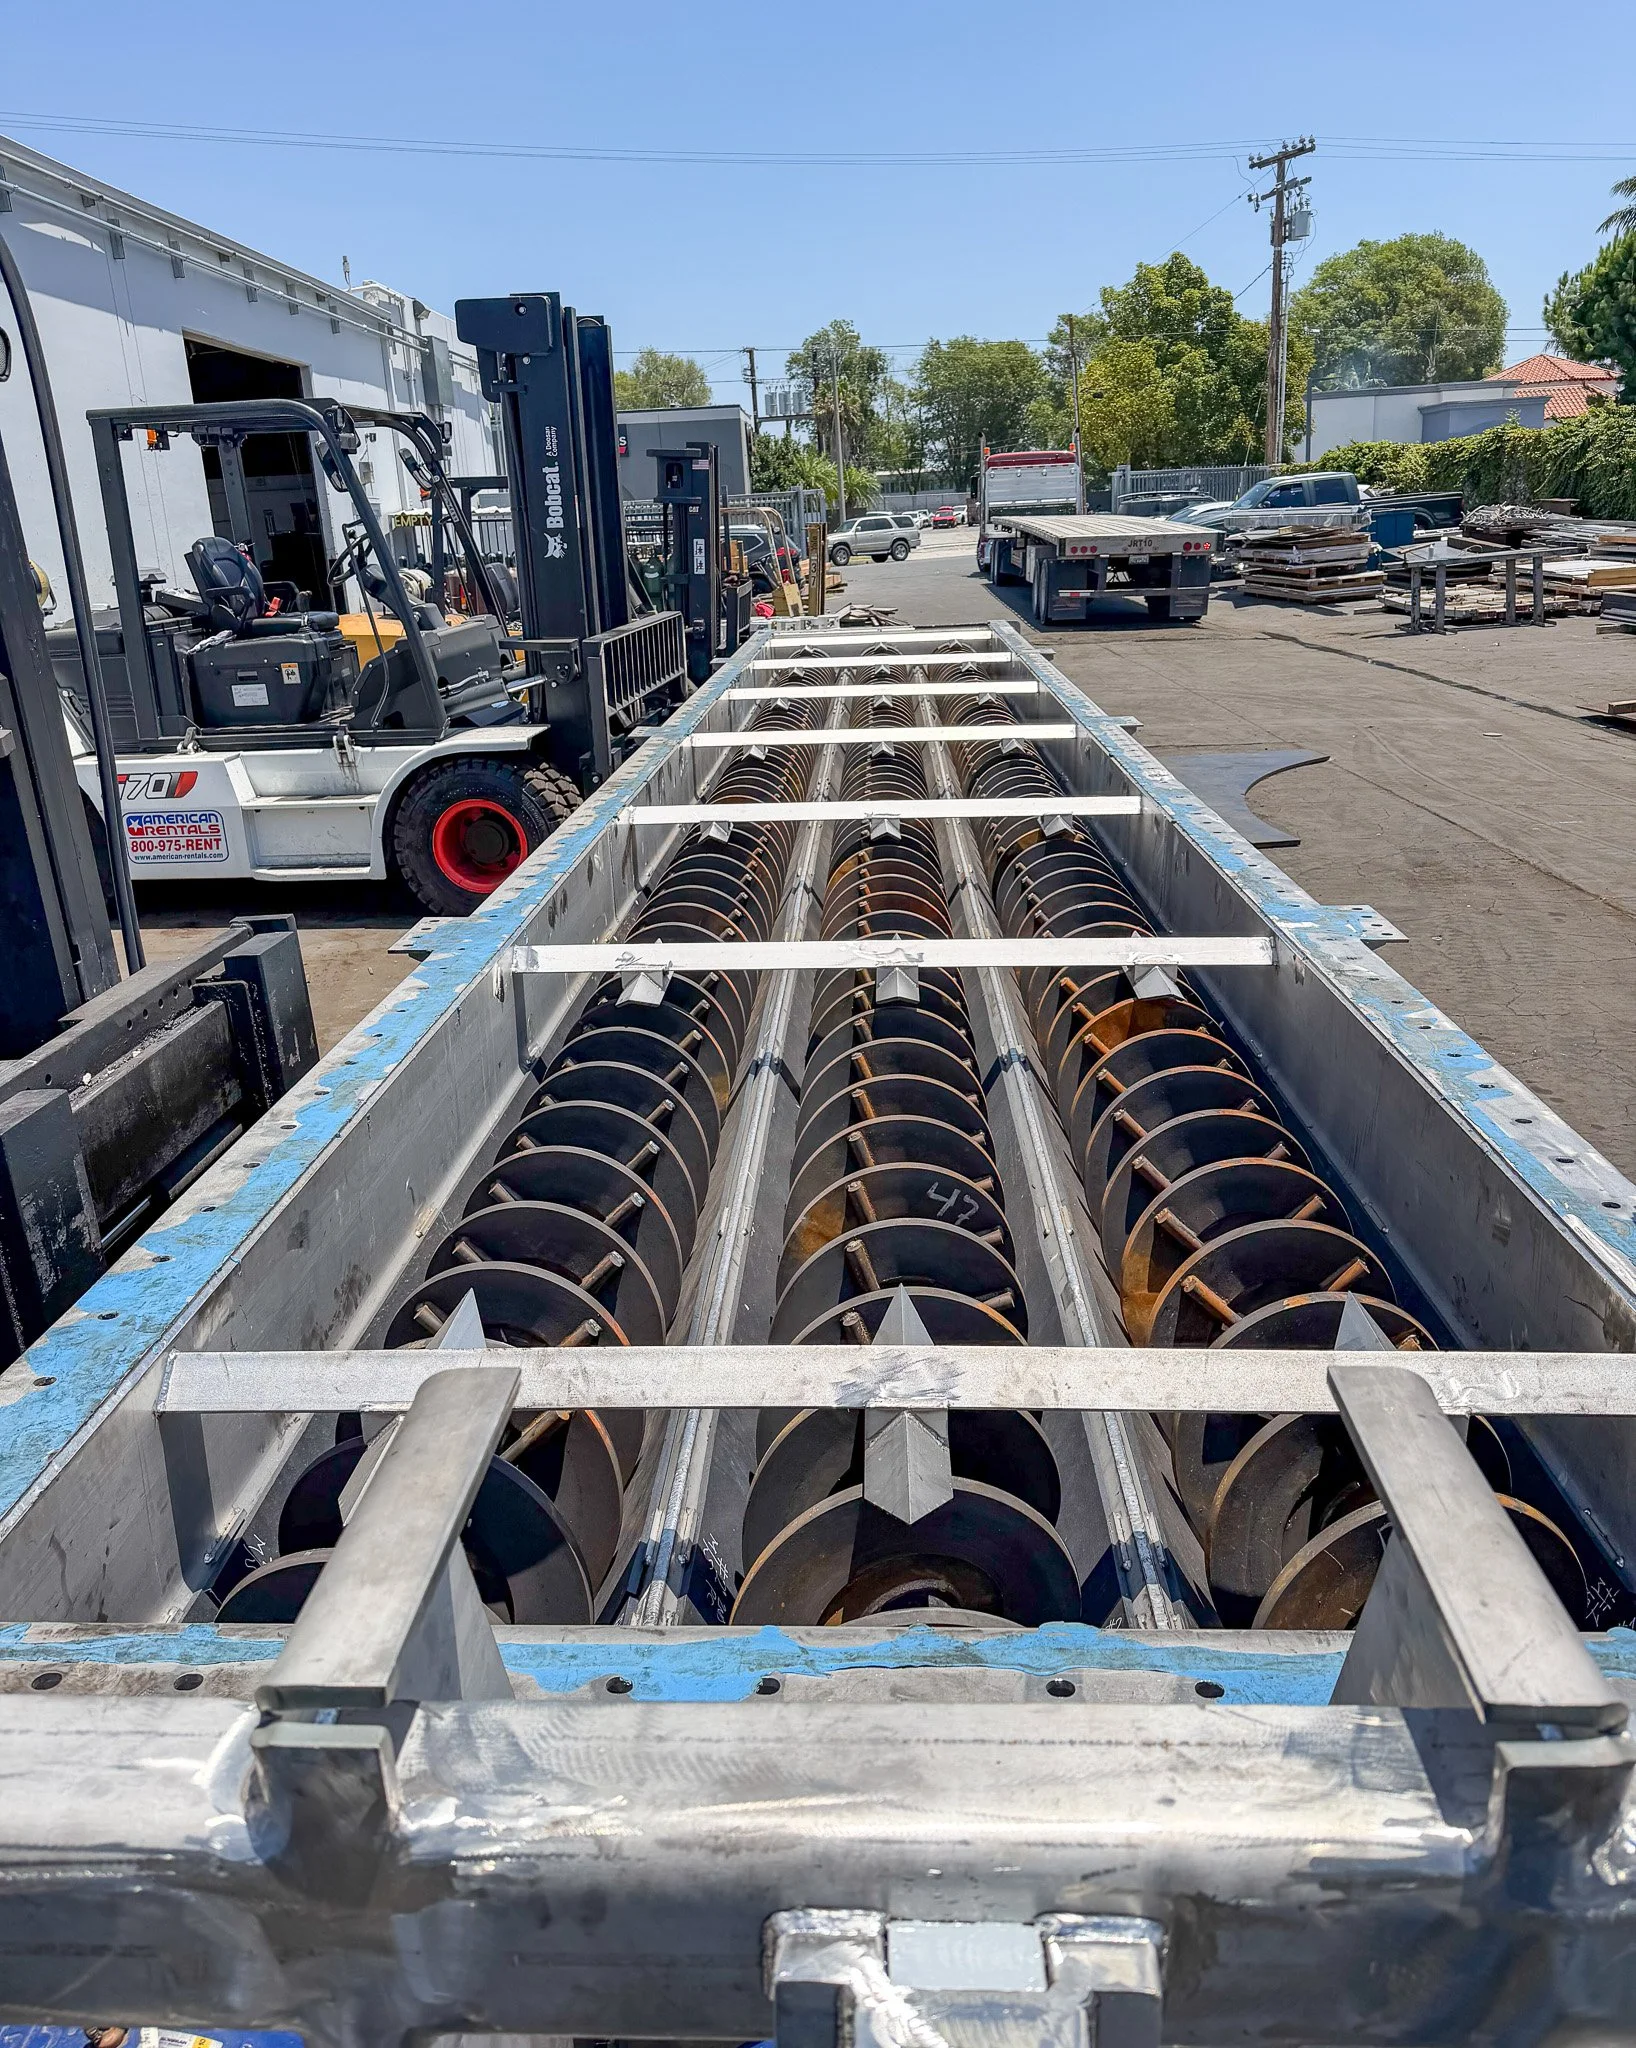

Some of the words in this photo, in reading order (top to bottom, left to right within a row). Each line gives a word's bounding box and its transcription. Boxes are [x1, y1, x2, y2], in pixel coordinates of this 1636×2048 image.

[394, 515, 433, 527] EMPTY
[1128, 539, 1152, 547] JRT10
[143, 813, 219, 825] AMERICAN
[144, 824, 221, 836] RENTALS
[131, 838, 222, 853] 800-975-RENT
[134, 853, 223, 861] www.american-rentals.com
